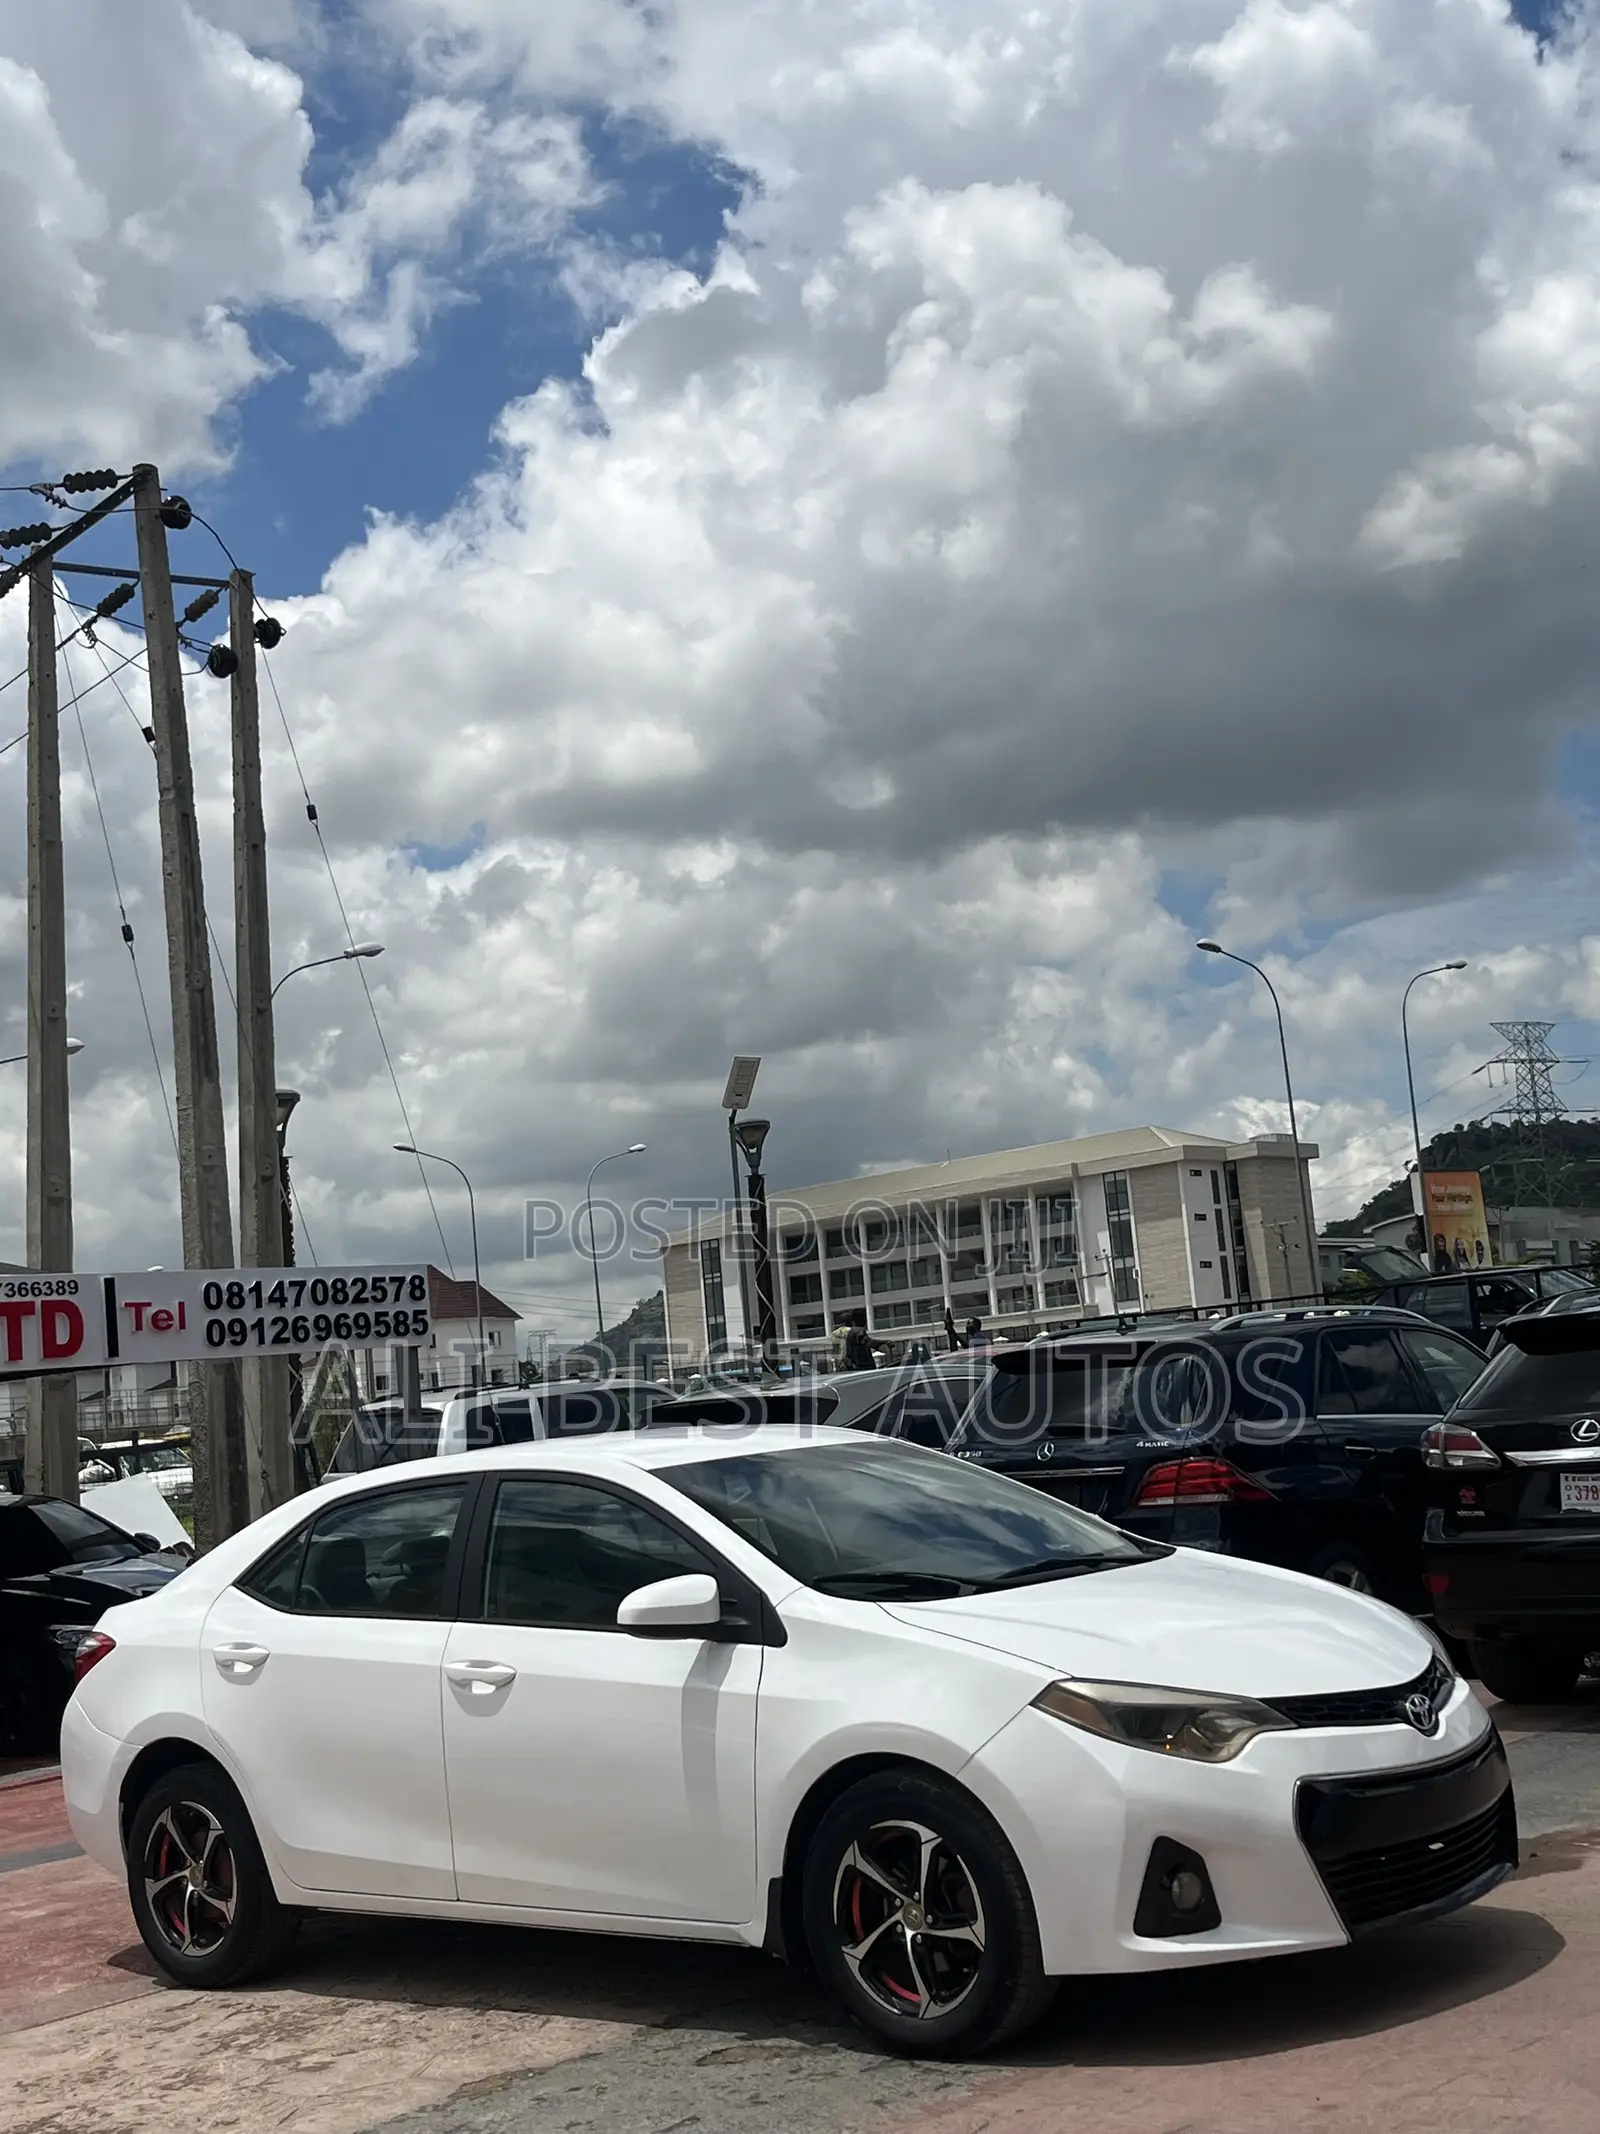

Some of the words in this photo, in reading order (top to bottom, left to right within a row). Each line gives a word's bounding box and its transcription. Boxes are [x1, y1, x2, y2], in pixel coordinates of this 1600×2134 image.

[0, 1280, 79, 1298] 366389
[203, 1274, 426, 1311] 08147082578
[124, 1301, 187, 1332] Tel
[206, 1309, 429, 1347] 09126969585
